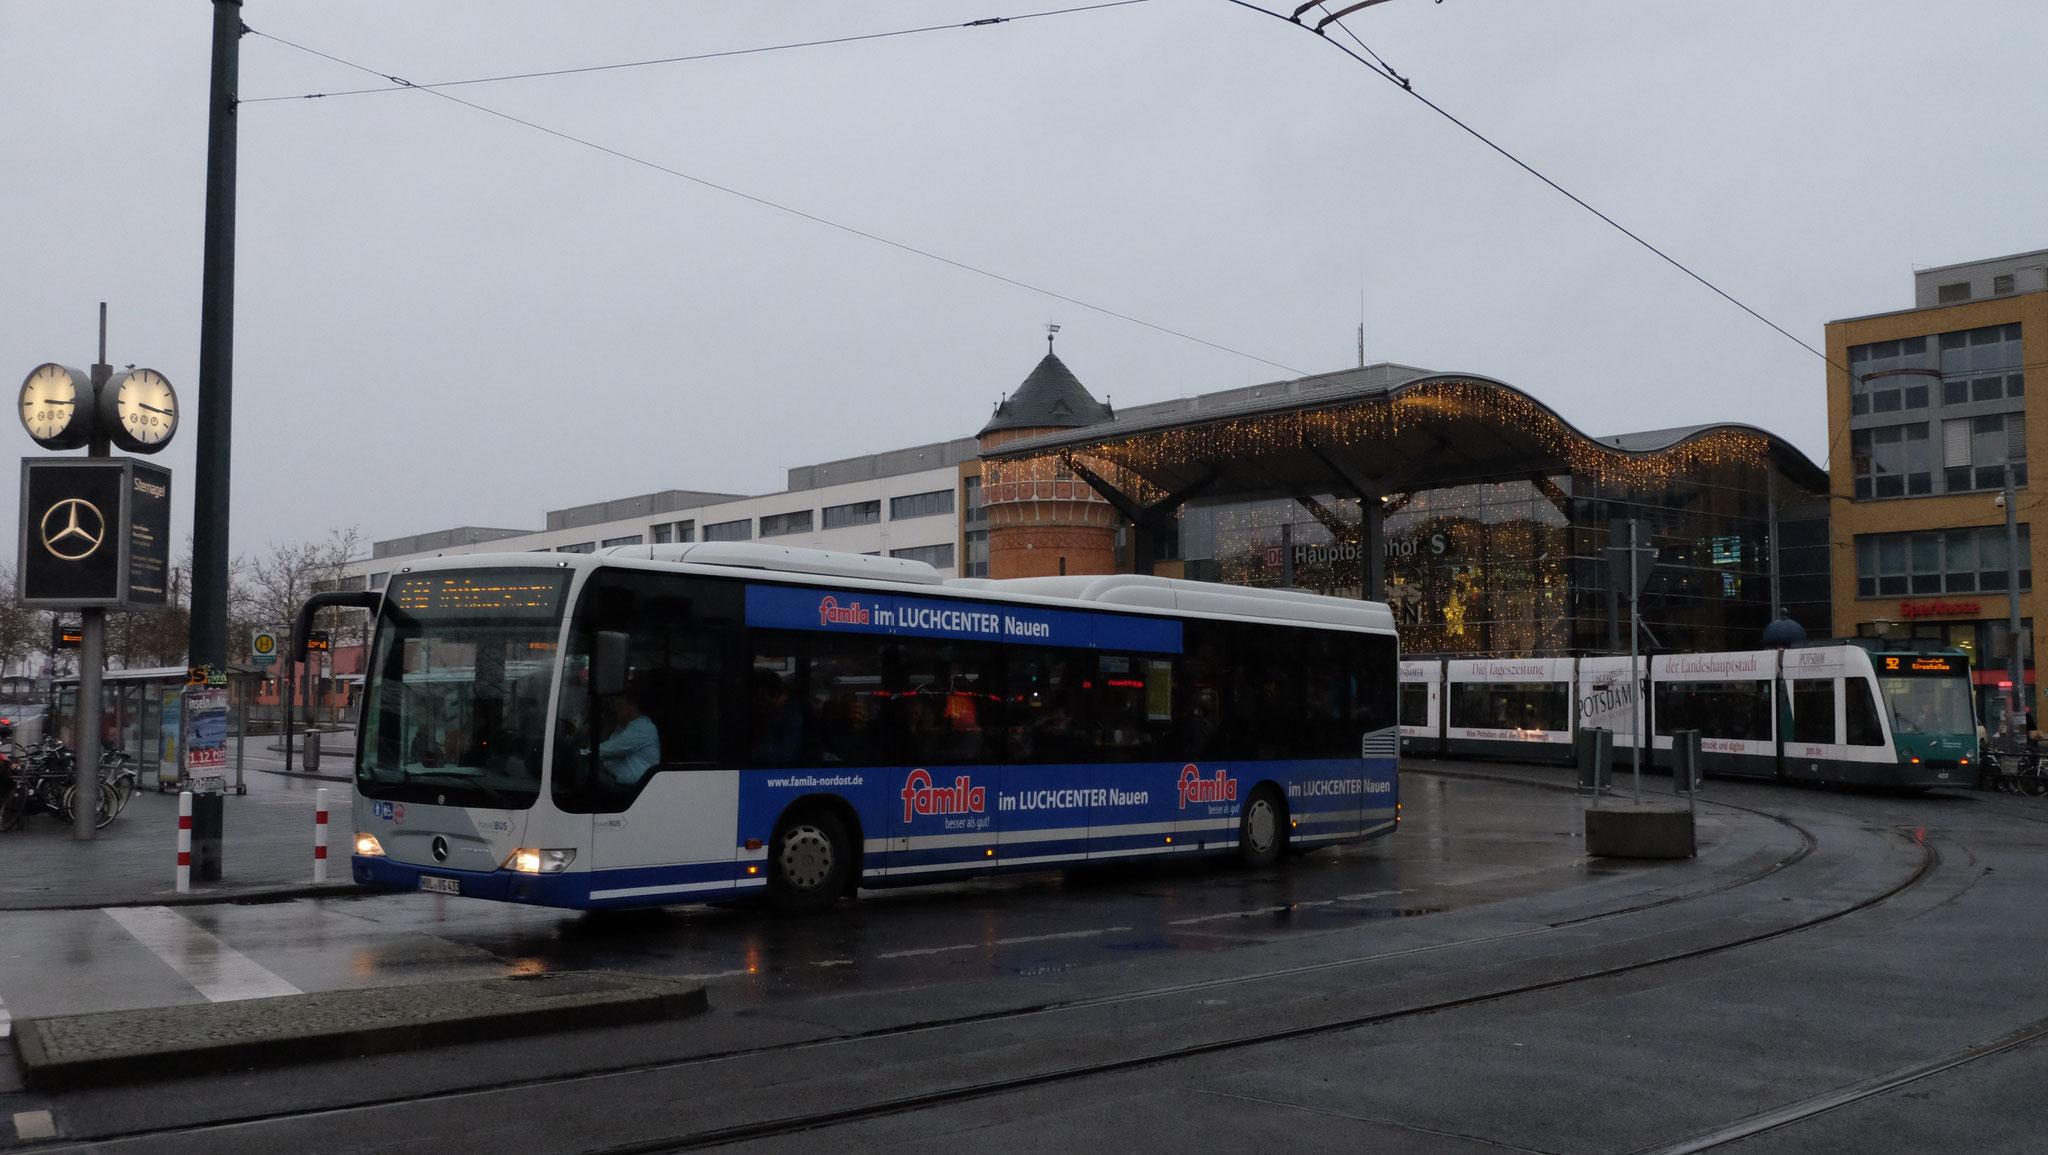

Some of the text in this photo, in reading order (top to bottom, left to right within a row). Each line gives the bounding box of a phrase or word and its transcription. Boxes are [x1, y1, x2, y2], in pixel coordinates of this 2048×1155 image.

[1295, 537, 1418, 564] Hauptbahof
[819, 595, 1049, 638] famila im LUCHCENTER Nauen
[1900, 600, 1980, 618] Sparkasse
[1472, 662, 1545, 678] Die Tageszeitung
[1665, 654, 1757, 677] der Landeshauptstadt
[1885, 657, 1900, 670] 92
[1400, 668, 1424, 678] TSDAMER
[1577, 677, 1648, 721] POTSDAMR
[1477, 730, 1497, 738] Potsdam
[1498, 731, 1507, 739] und
[1701, 741, 1745, 752] druckt und digital
[767, 774, 863, 788] www.famila-nordost.de
[1177, 763, 1237, 810] famila
[1288, 778, 1391, 797] im LUCHCENTER Nauen
[901, 768, 985, 823] famila
[998, 788, 1149, 811] im LUCHCENTER Nauen
[945, 816, 990, 831] besser als gut!
[448, 879, 460, 892] 433
